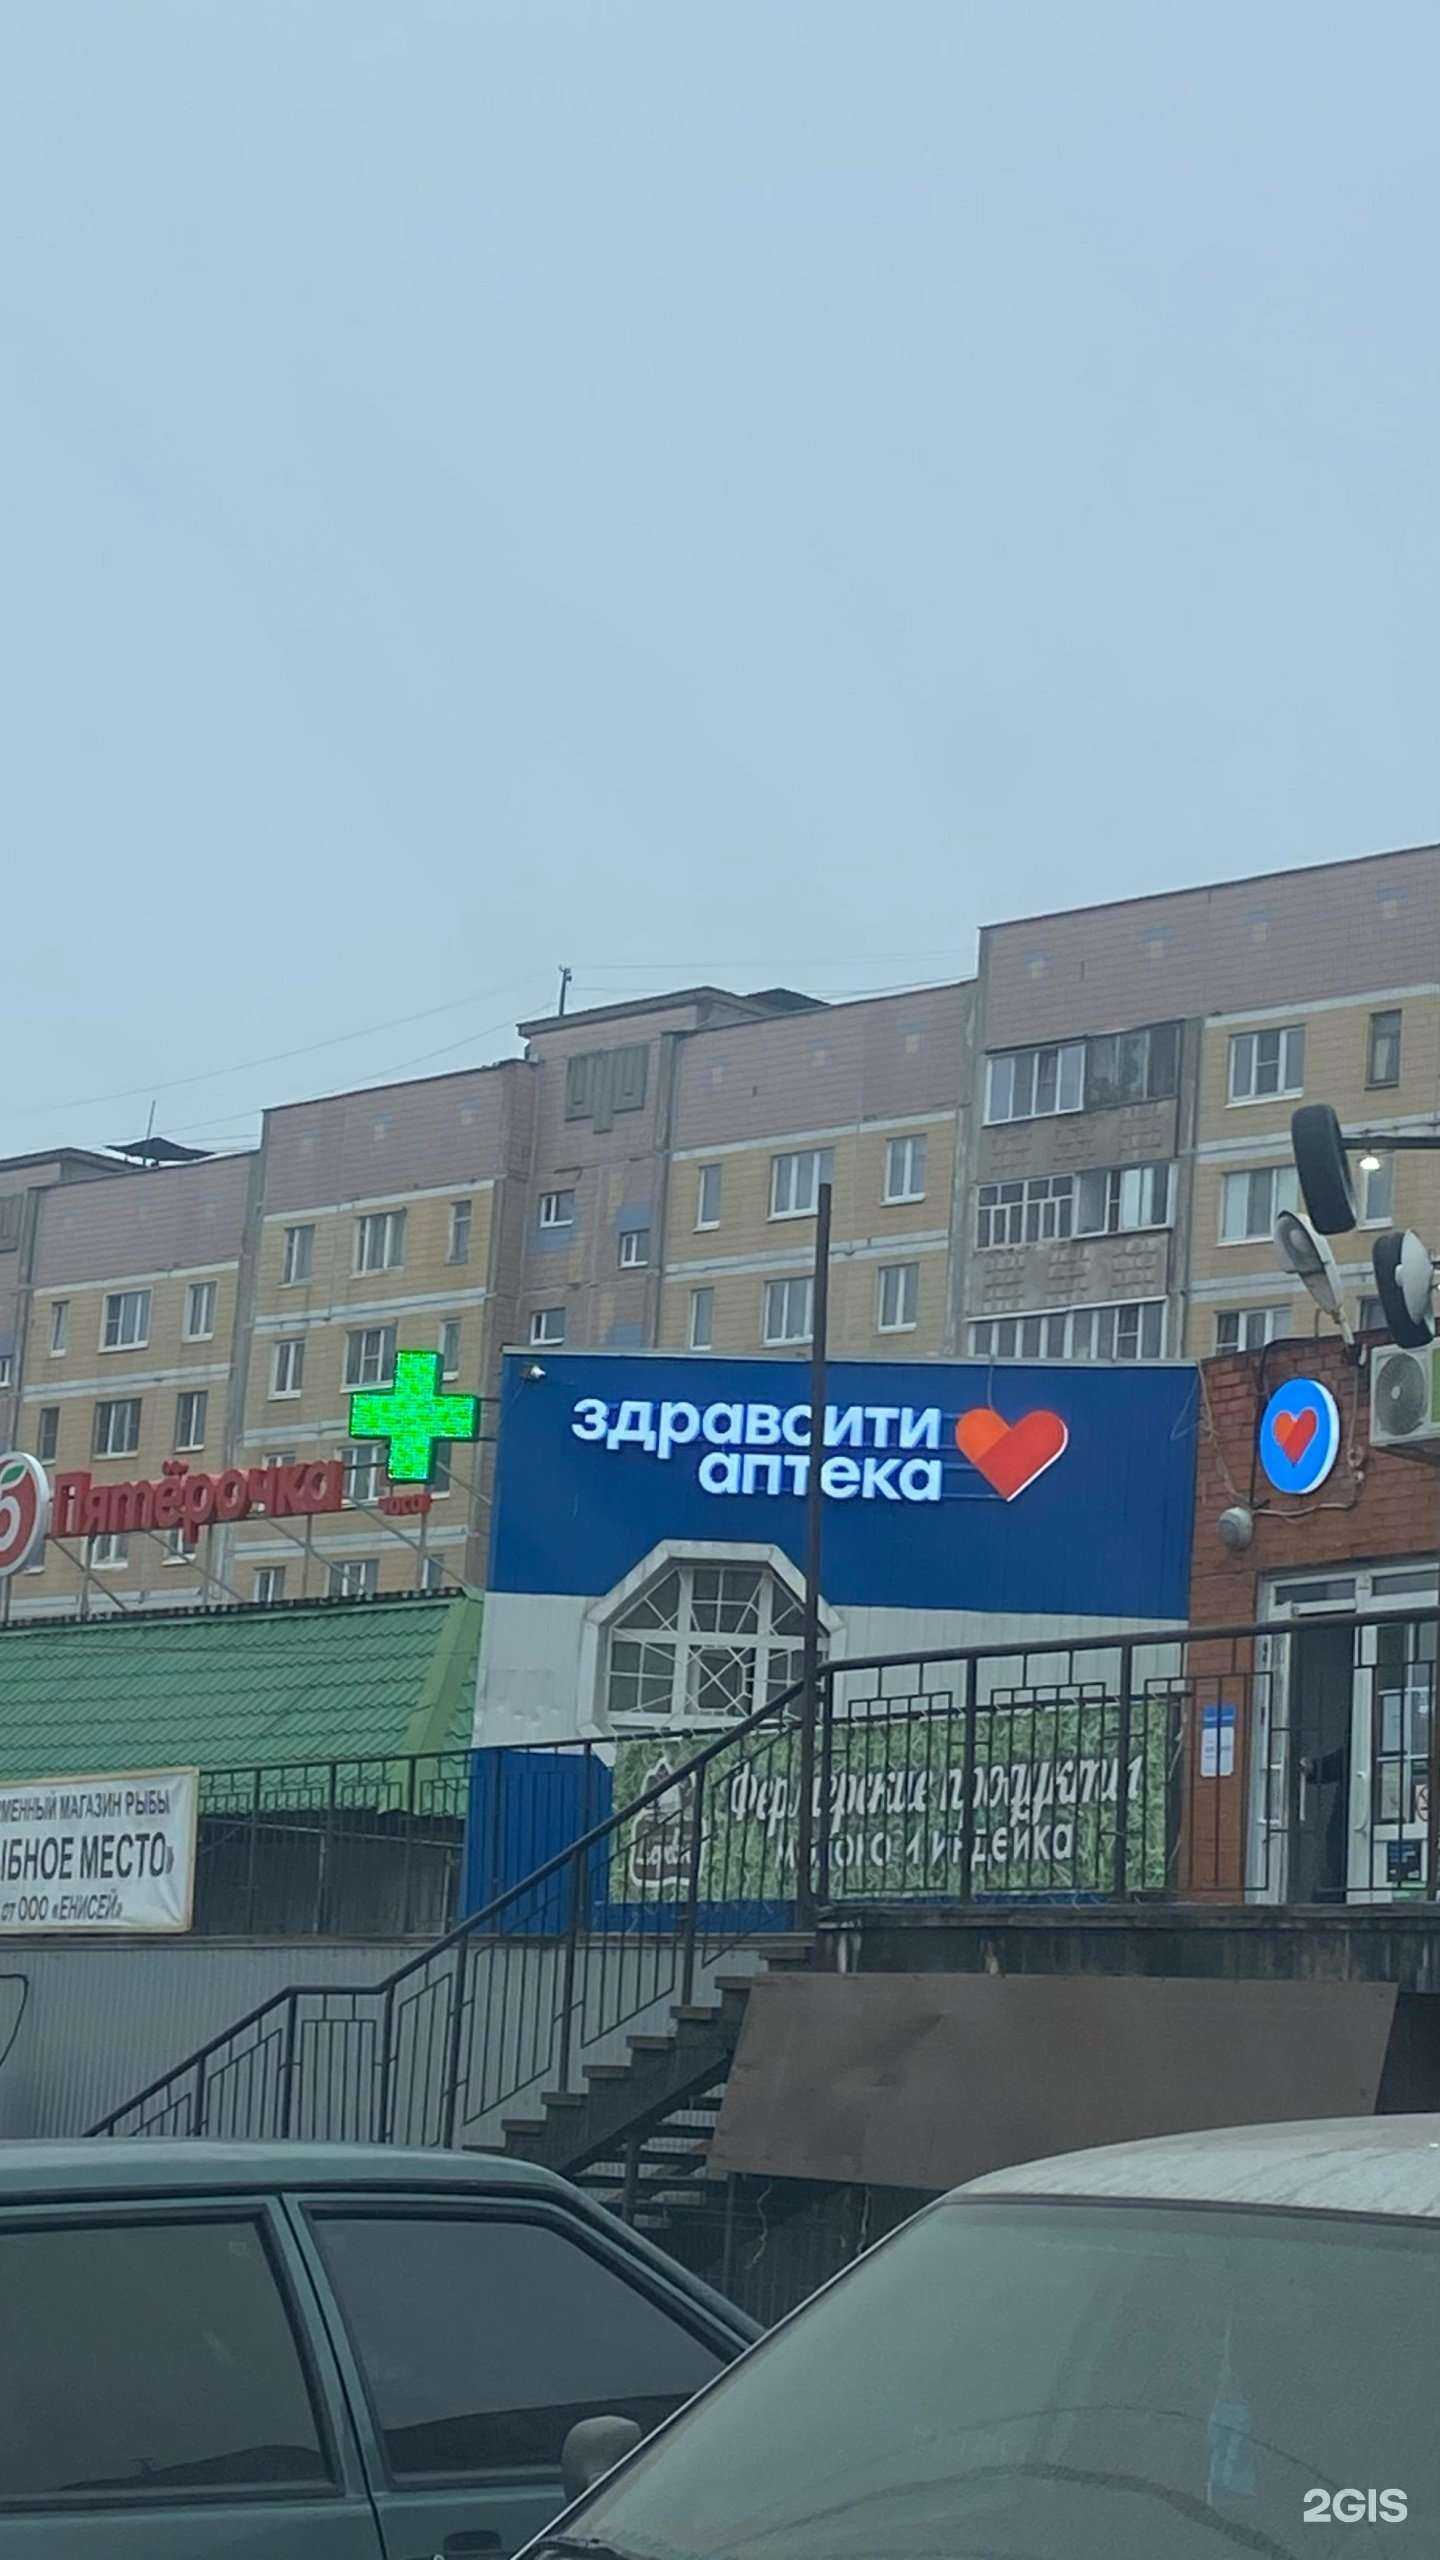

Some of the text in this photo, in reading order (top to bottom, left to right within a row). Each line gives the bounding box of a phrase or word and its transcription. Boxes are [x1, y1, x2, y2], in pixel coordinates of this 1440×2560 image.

[572, 1398, 942, 1460] здравсити
[52, 1459, 344, 1544] Пятёрочка
[699, 1452, 943, 1501] аптека
[60, 1793, 121, 1821] МАГАЗИН
[126, 1790, 171, 1816] РЫБЫ
